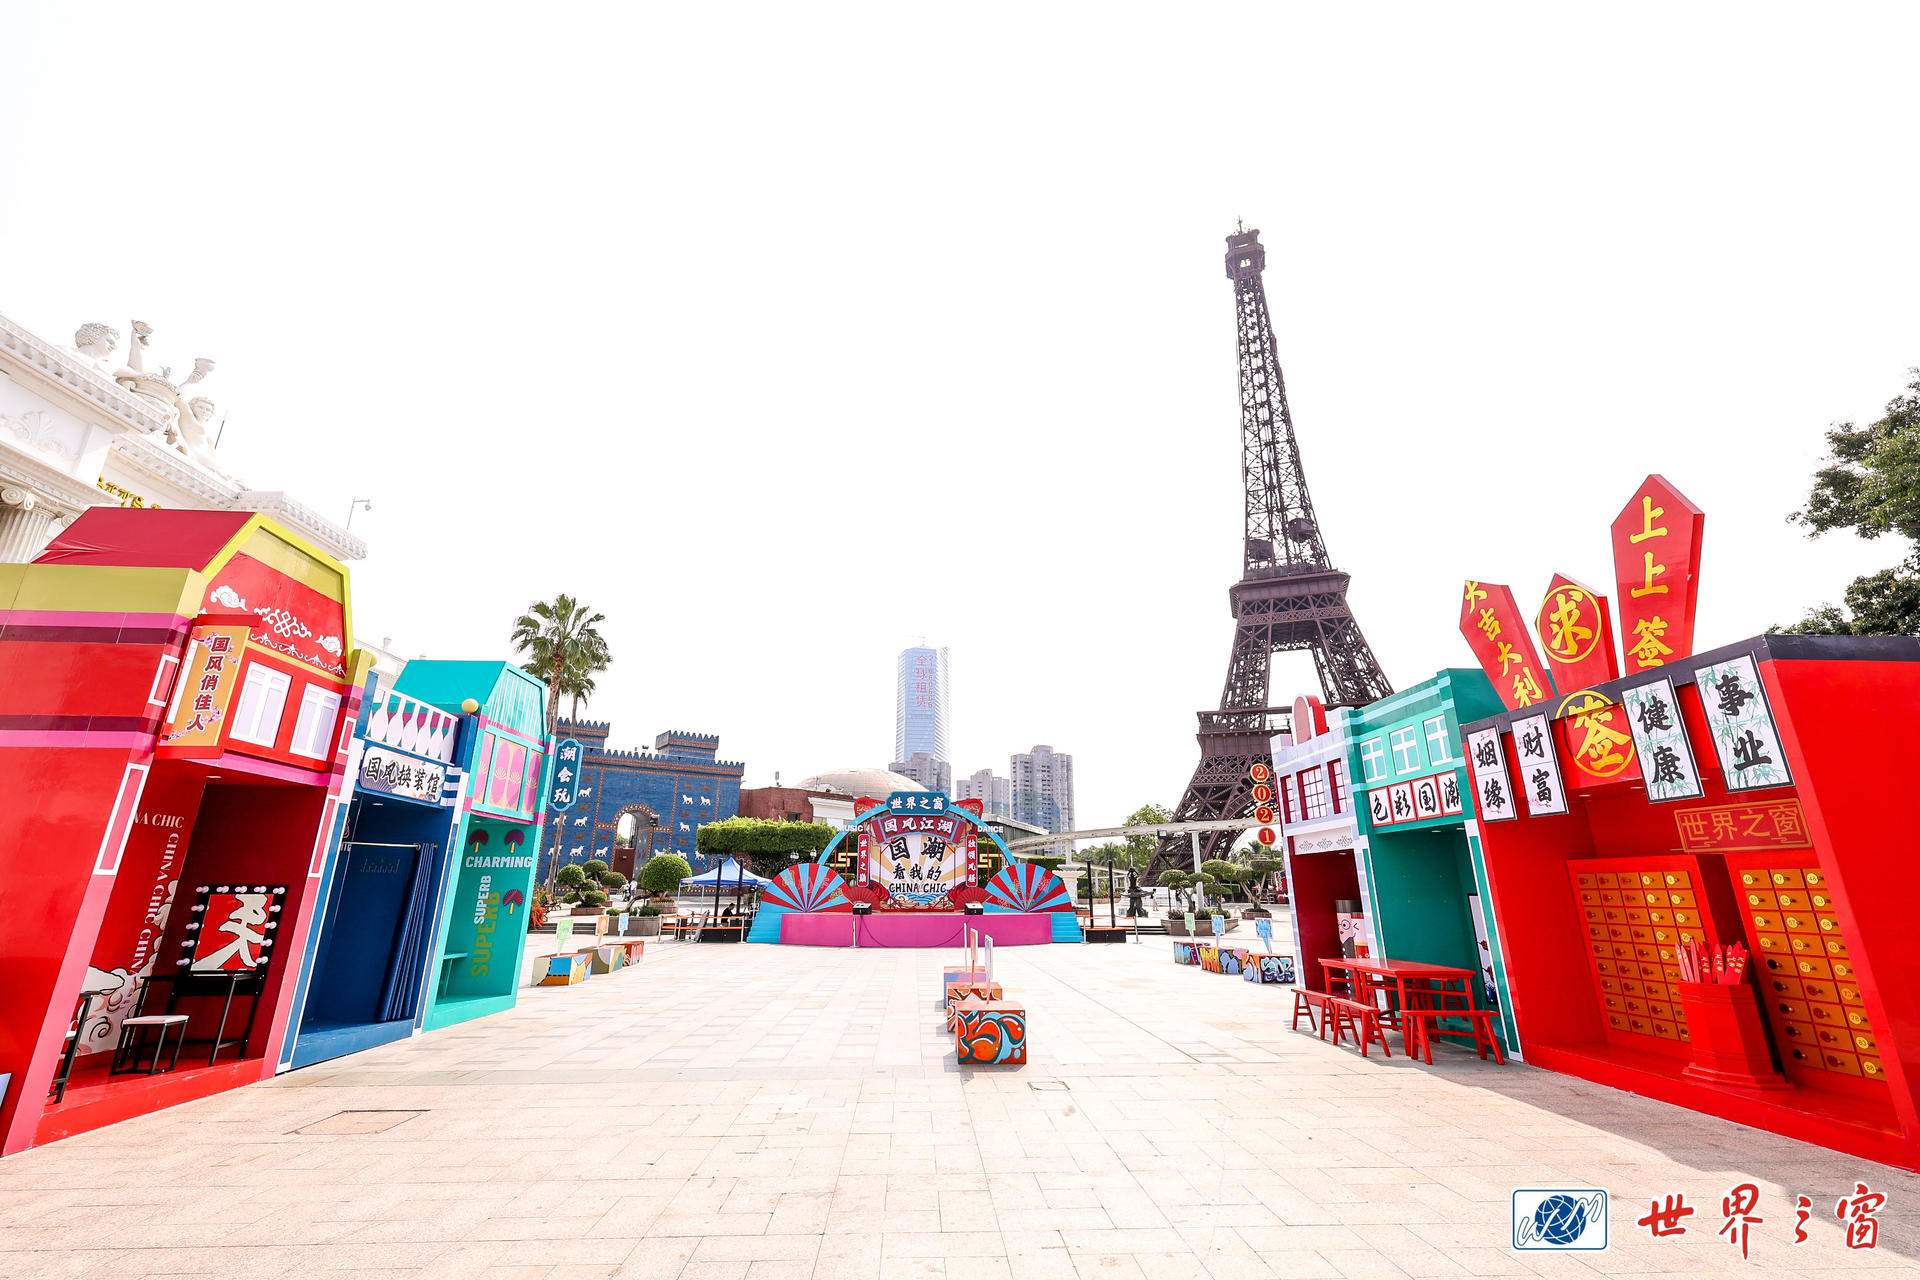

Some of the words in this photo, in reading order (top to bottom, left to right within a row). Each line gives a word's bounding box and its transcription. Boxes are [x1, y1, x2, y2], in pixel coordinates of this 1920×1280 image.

[1627, 495, 1674, 668] 上上签
[1465, 580, 1543, 709] 大吉大利
[1549, 590, 1593, 655] 求
[185, 636, 231, 732] 国风俏佳人
[1568, 695, 1632, 771] 签
[1637, 695, 1685, 784] 健康
[1715, 674, 1773, 772] 事业
[366, 756, 441, 800] 国风换装馆
[553, 746, 577, 803] 潮会玩
[1476, 739, 1506, 809] 姻缘
[1522, 725, 1553, 803] 财富
[151, 813, 185, 829] CHIC
[890, 796, 945, 810] 世界之窗
[1373, 777, 1460, 822] 色彩国潮
[836, 824, 864, 832] MUSIC
[883, 817, 954, 834] 国风江湖
[977, 825, 1004, 833] DANCE
[1681, 805, 1802, 842] 世界之窗
[156, 832, 180, 882] CHINA
[465, 856, 533, 868] CHARMING
[889, 836, 948, 862] 国潮
[892, 863, 942, 882] 看我的
[144, 884, 165, 925] CHIC
[474, 875, 492, 925] SUPERB
[888, 883, 922, 893] CHINA
[923, 883, 947, 893] CHIC
[470, 891, 501, 977] SUPERB
